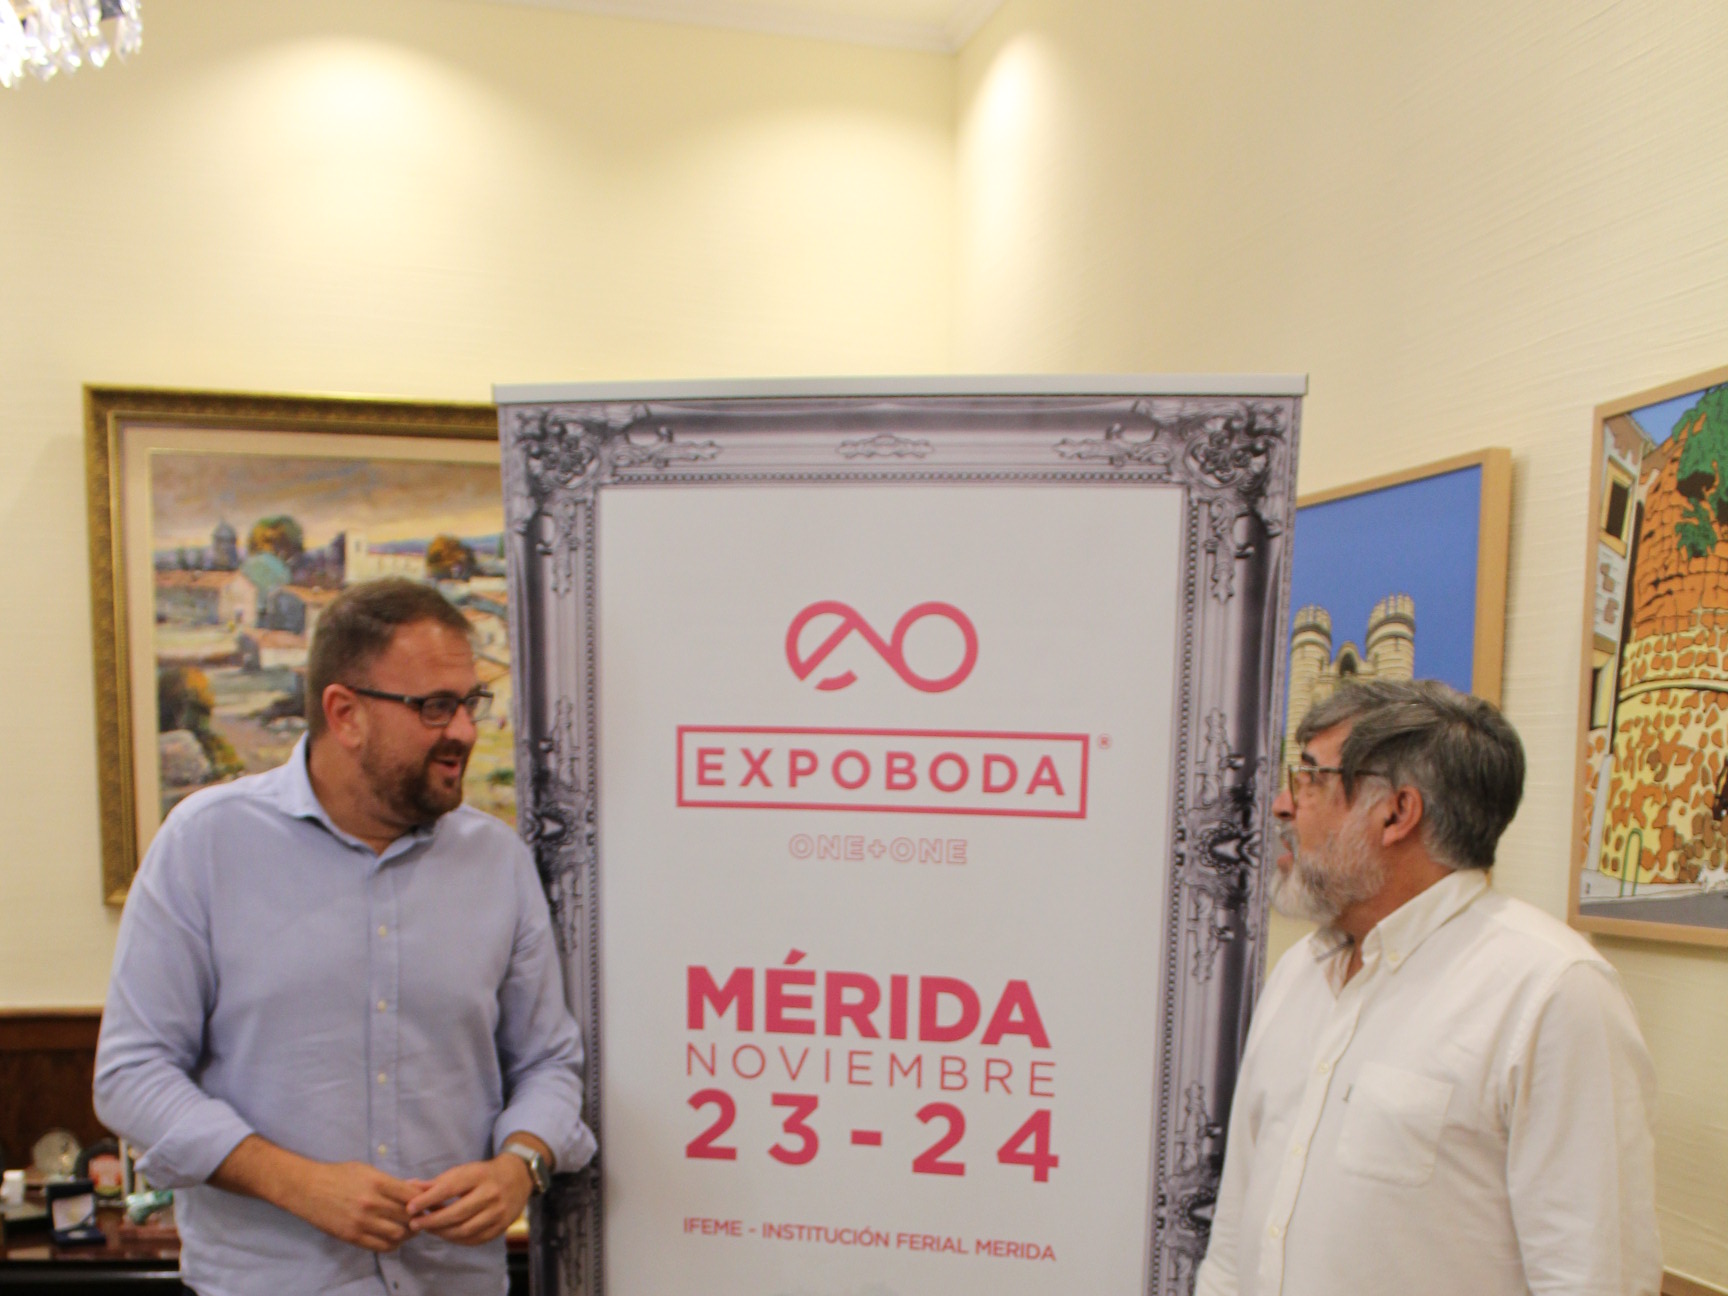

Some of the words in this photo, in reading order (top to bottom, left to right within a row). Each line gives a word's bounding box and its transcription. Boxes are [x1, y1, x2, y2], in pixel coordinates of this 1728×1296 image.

[696, 747, 1066, 797] EXPOBODA
[789, 834, 968, 866] ONE+ONE
[687, 948, 1052, 1050] MÉRIDA
[687, 1042, 1056, 1098] NOVIEMBRE
[683, 1216, 743, 1237] IFEME
[761, 1222, 890, 1248] INSTITUCIÓN
[896, 1232, 969, 1255] FERIAL
[975, 1239, 1057, 1262] MERIDA
